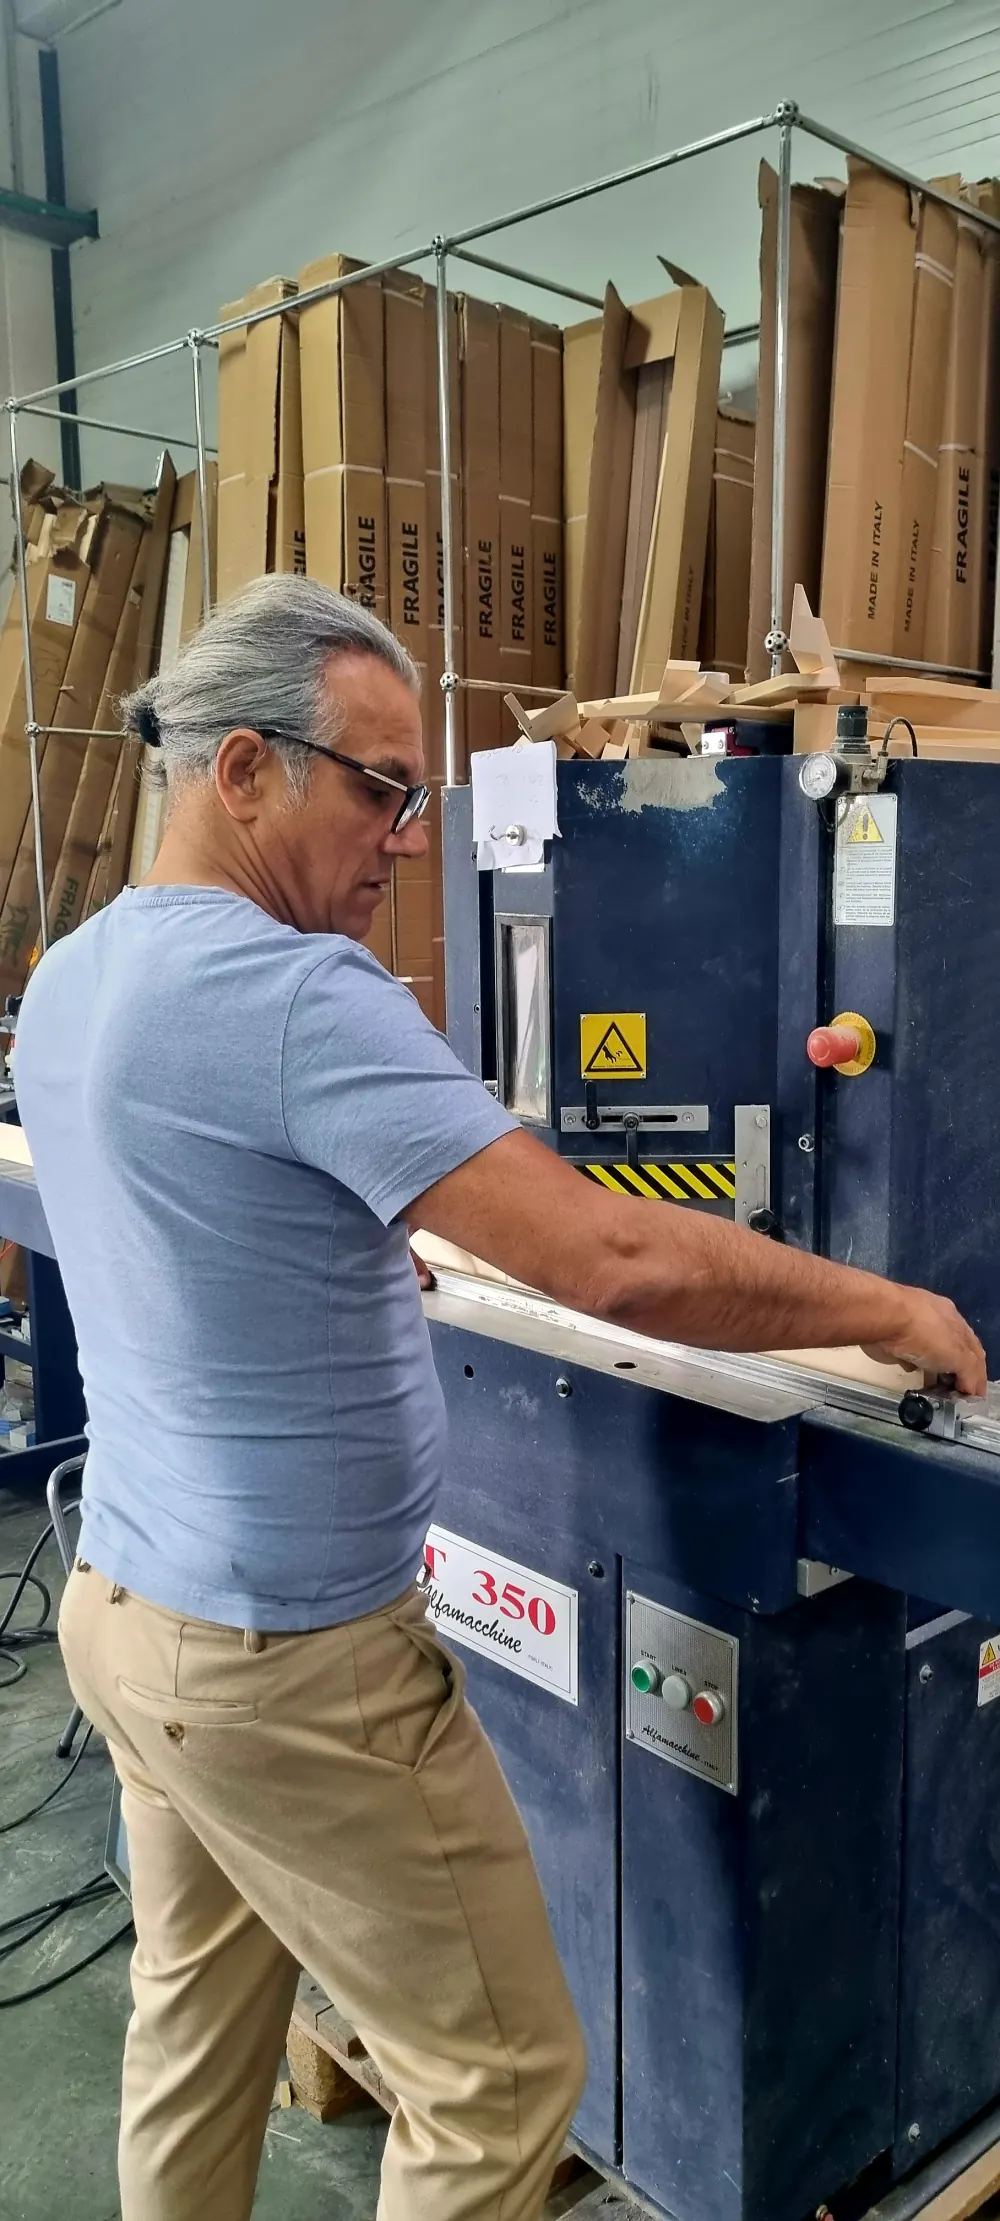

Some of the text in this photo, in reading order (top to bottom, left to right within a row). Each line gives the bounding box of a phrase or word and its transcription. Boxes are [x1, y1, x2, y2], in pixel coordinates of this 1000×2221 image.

[358, 516, 376, 608] RAGILE
[868, 500, 883, 619] MADE IN ITALY
[956, 466, 970, 584] FRAGILE
[402, 522, 419, 626] FRAGILE
[478, 540, 492, 639] FRAGILE
[511, 544, 524, 641] FRAGILE
[543, 552, 556, 646] FRAGILE
[904, 519, 920, 632] MADE IN ITALY
[54, 877, 79, 934] FRAG
[472, 1570, 556, 1635] 350
[641, 1650, 656, 1661] START
[703, 1680, 718, 1690] STOP
[642, 1724, 700, 1761] Alfamacchine
